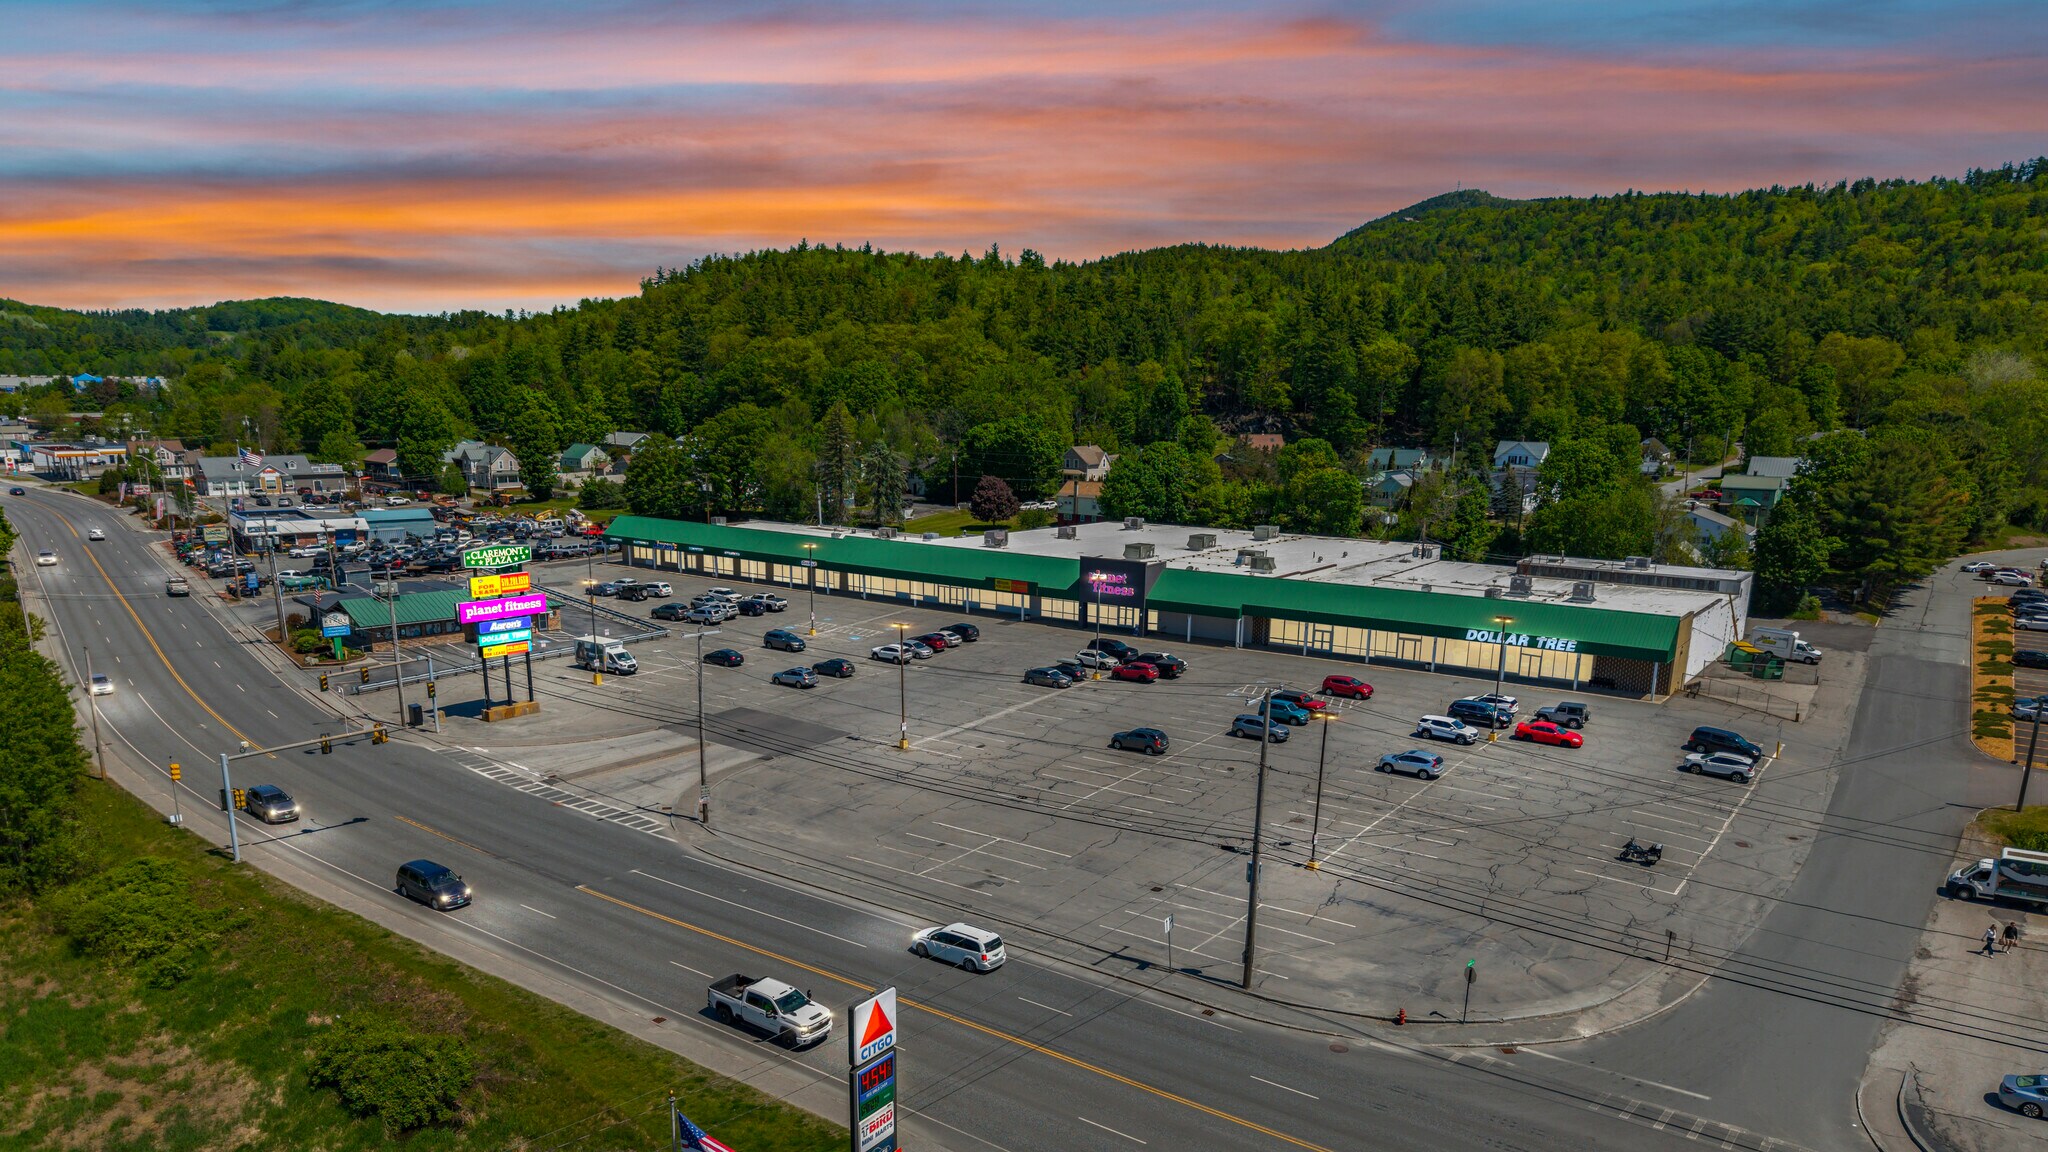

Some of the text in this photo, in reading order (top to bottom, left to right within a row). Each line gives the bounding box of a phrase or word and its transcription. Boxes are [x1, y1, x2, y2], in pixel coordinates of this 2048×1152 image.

[470, 547, 524, 559] CLAREMONT
[485, 556, 512, 566] PLAZA
[1088, 571, 1127, 583] pnet
[1093, 582, 1134, 596] fitness
[466, 600, 541, 619] planet fitness
[490, 620, 522, 631] Aaron's
[1466, 629, 1577, 652] DOLLAR TREE
[861, 1034, 893, 1060] CITGO
[862, 1062, 887, 1090] 4.54
[862, 1121, 893, 1147] MINI MARTS
